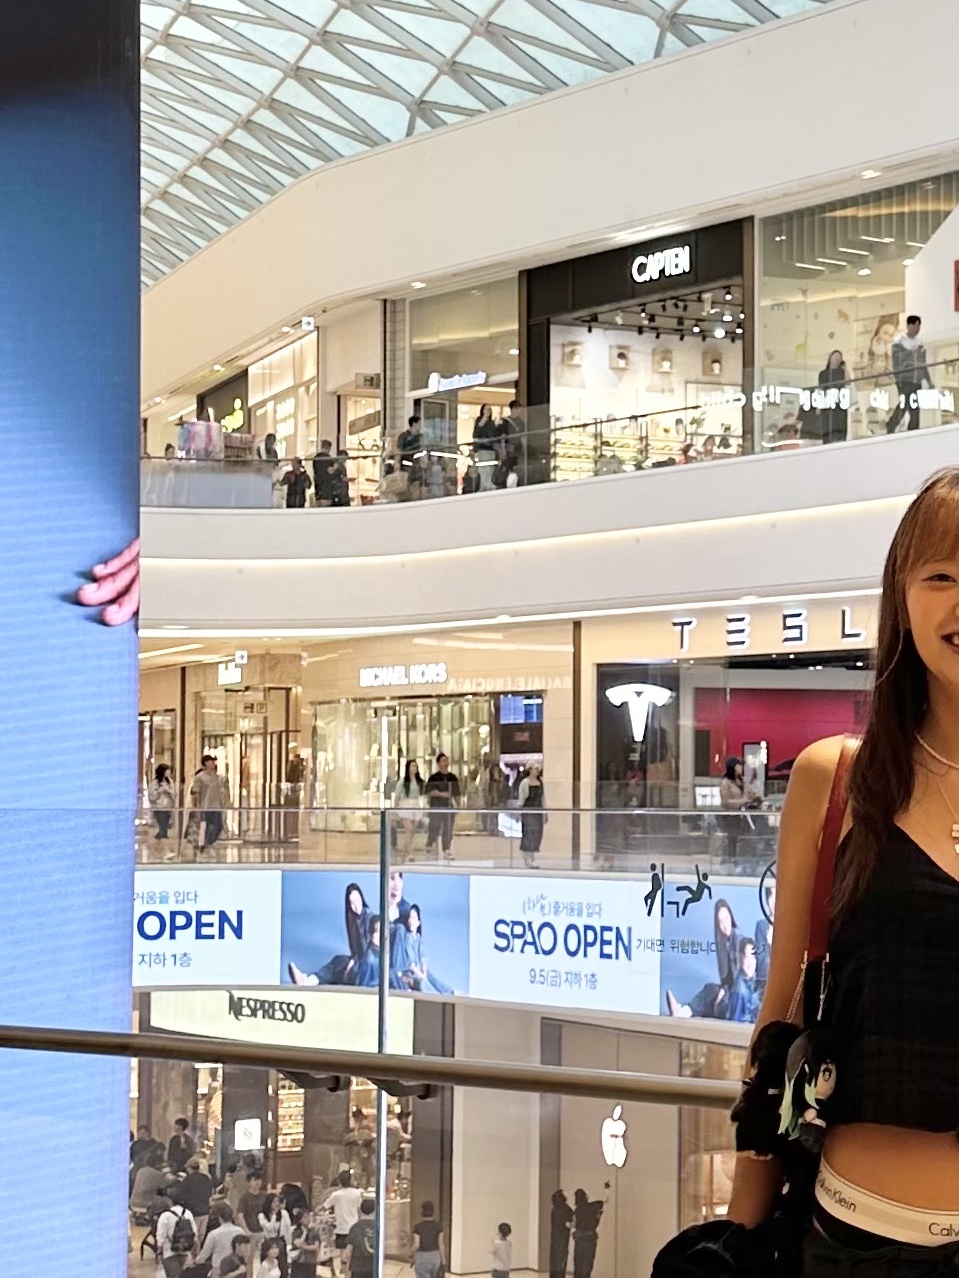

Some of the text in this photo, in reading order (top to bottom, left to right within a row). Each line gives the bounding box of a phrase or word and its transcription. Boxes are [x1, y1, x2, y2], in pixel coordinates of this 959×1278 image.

[631, 245, 690, 283] CAPTEN
[359, 665, 408, 687] MICHAEL
[410, 662, 448, 684] KORS
[173, 889, 199, 905] 입다
[585, 901, 602, 918] 입다
[136, 910, 243, 940] OPEN
[493, 918, 632, 961] SPAO OPEN
[636, 938, 665, 953] 기대면
[138, 952, 192, 968] 지하 1층
[564, 970, 582, 989] 지하
[584, 973, 598, 990] 1층
[225, 989, 306, 1023] NESPRESSO
